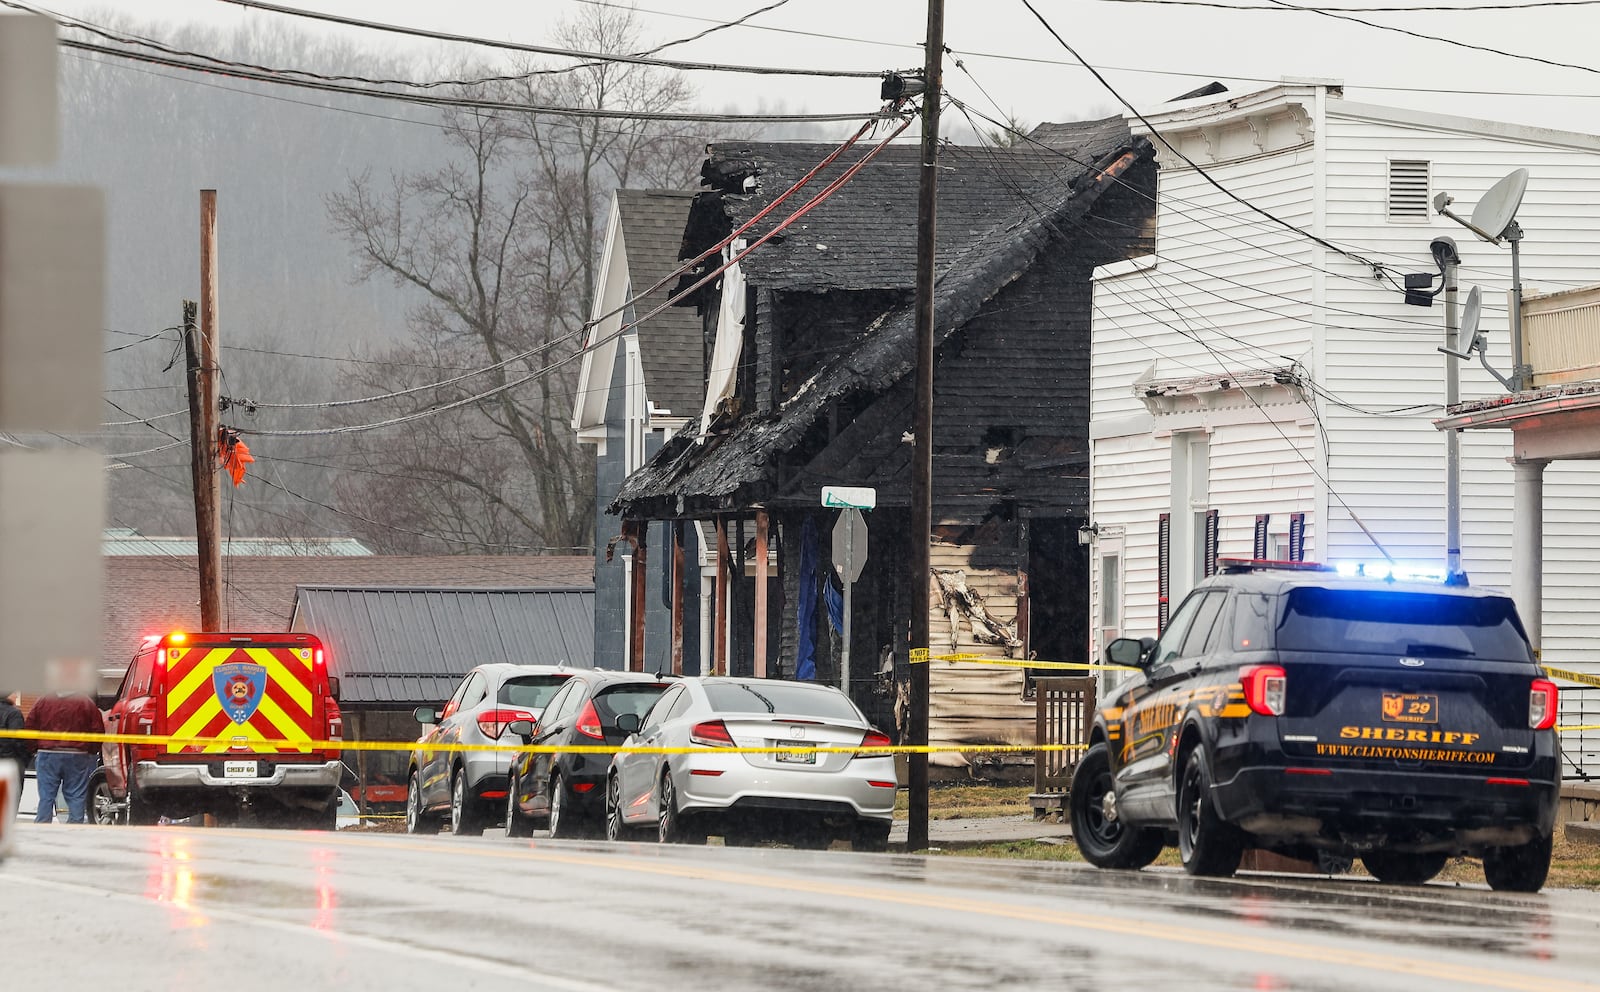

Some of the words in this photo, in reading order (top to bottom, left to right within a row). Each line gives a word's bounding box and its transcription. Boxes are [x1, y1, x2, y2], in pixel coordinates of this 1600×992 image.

[1386, 700, 1398, 711] 14
[1408, 702, 1430, 714] 29
[1340, 726, 1479, 745] SHERIFF
[1317, 744, 1495, 763] WWW.CLINTONSHERIFF.COM
